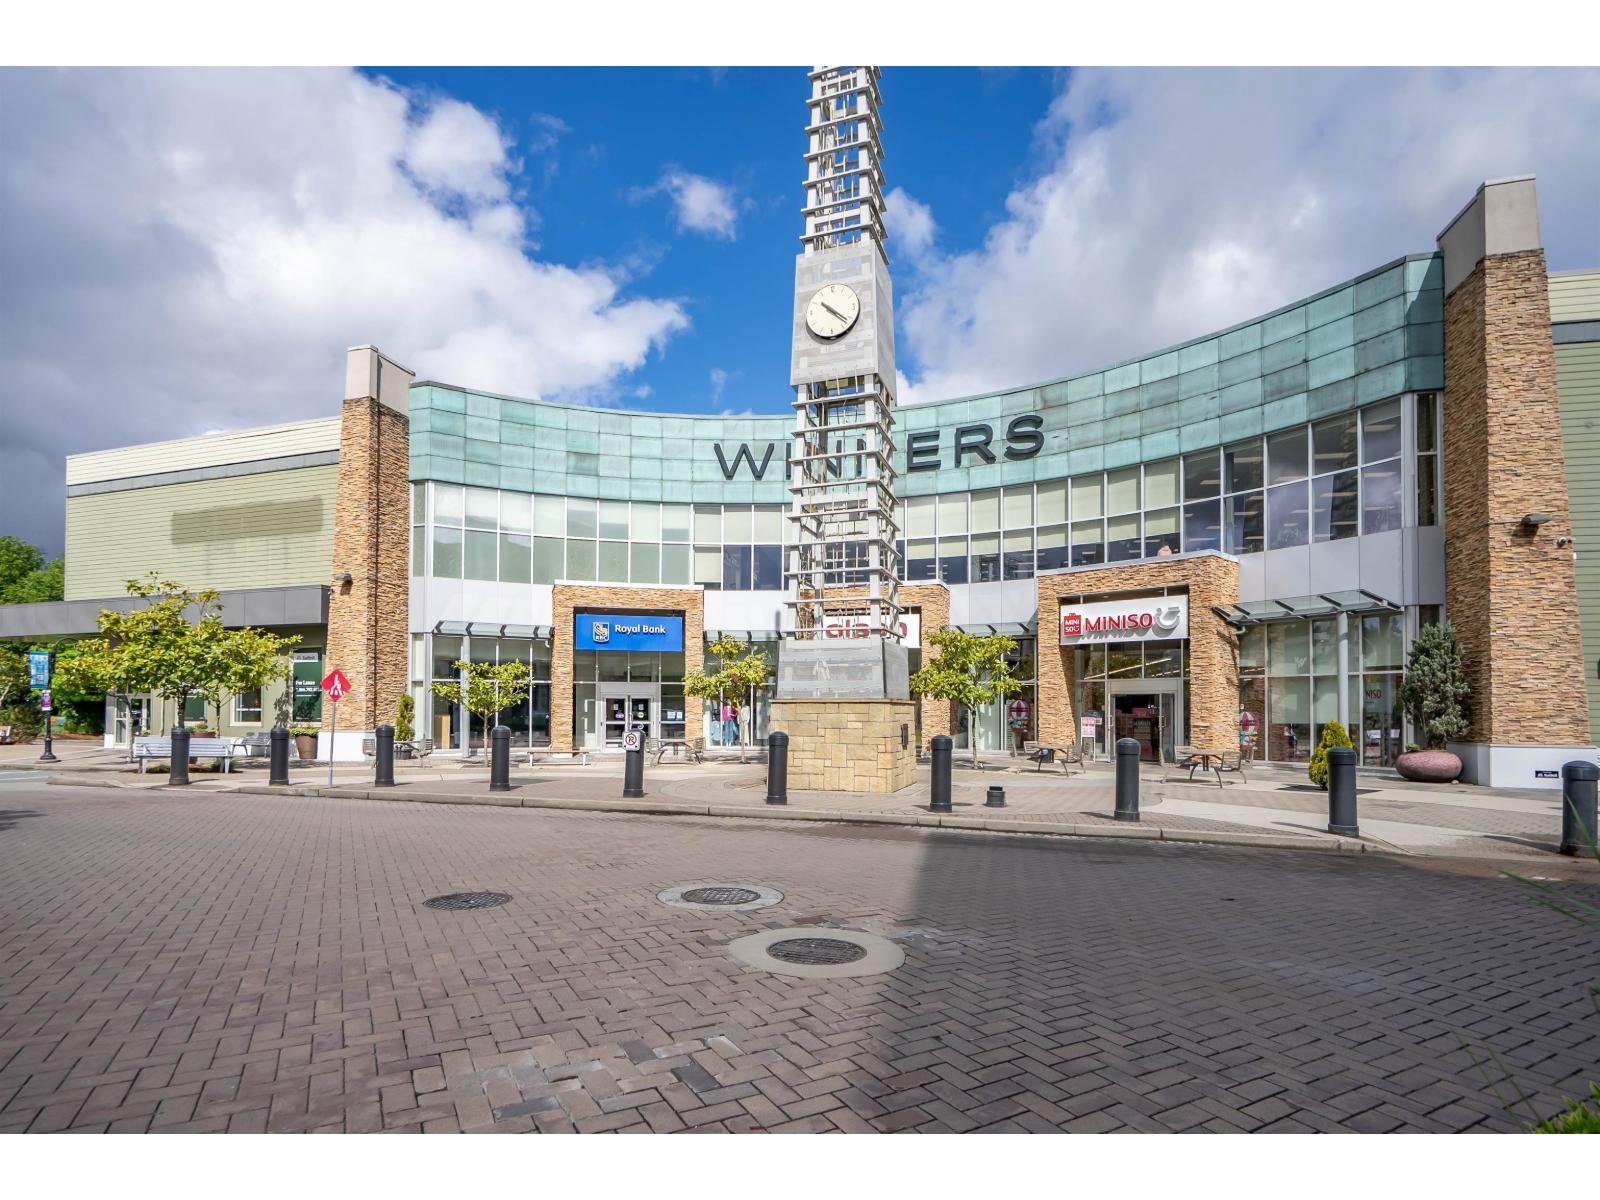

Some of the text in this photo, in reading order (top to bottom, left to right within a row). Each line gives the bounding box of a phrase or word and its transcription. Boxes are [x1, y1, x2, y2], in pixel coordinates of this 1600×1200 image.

[1085, 613, 1153, 631] MINISO
[615, 624, 666, 635] Royal Bank
